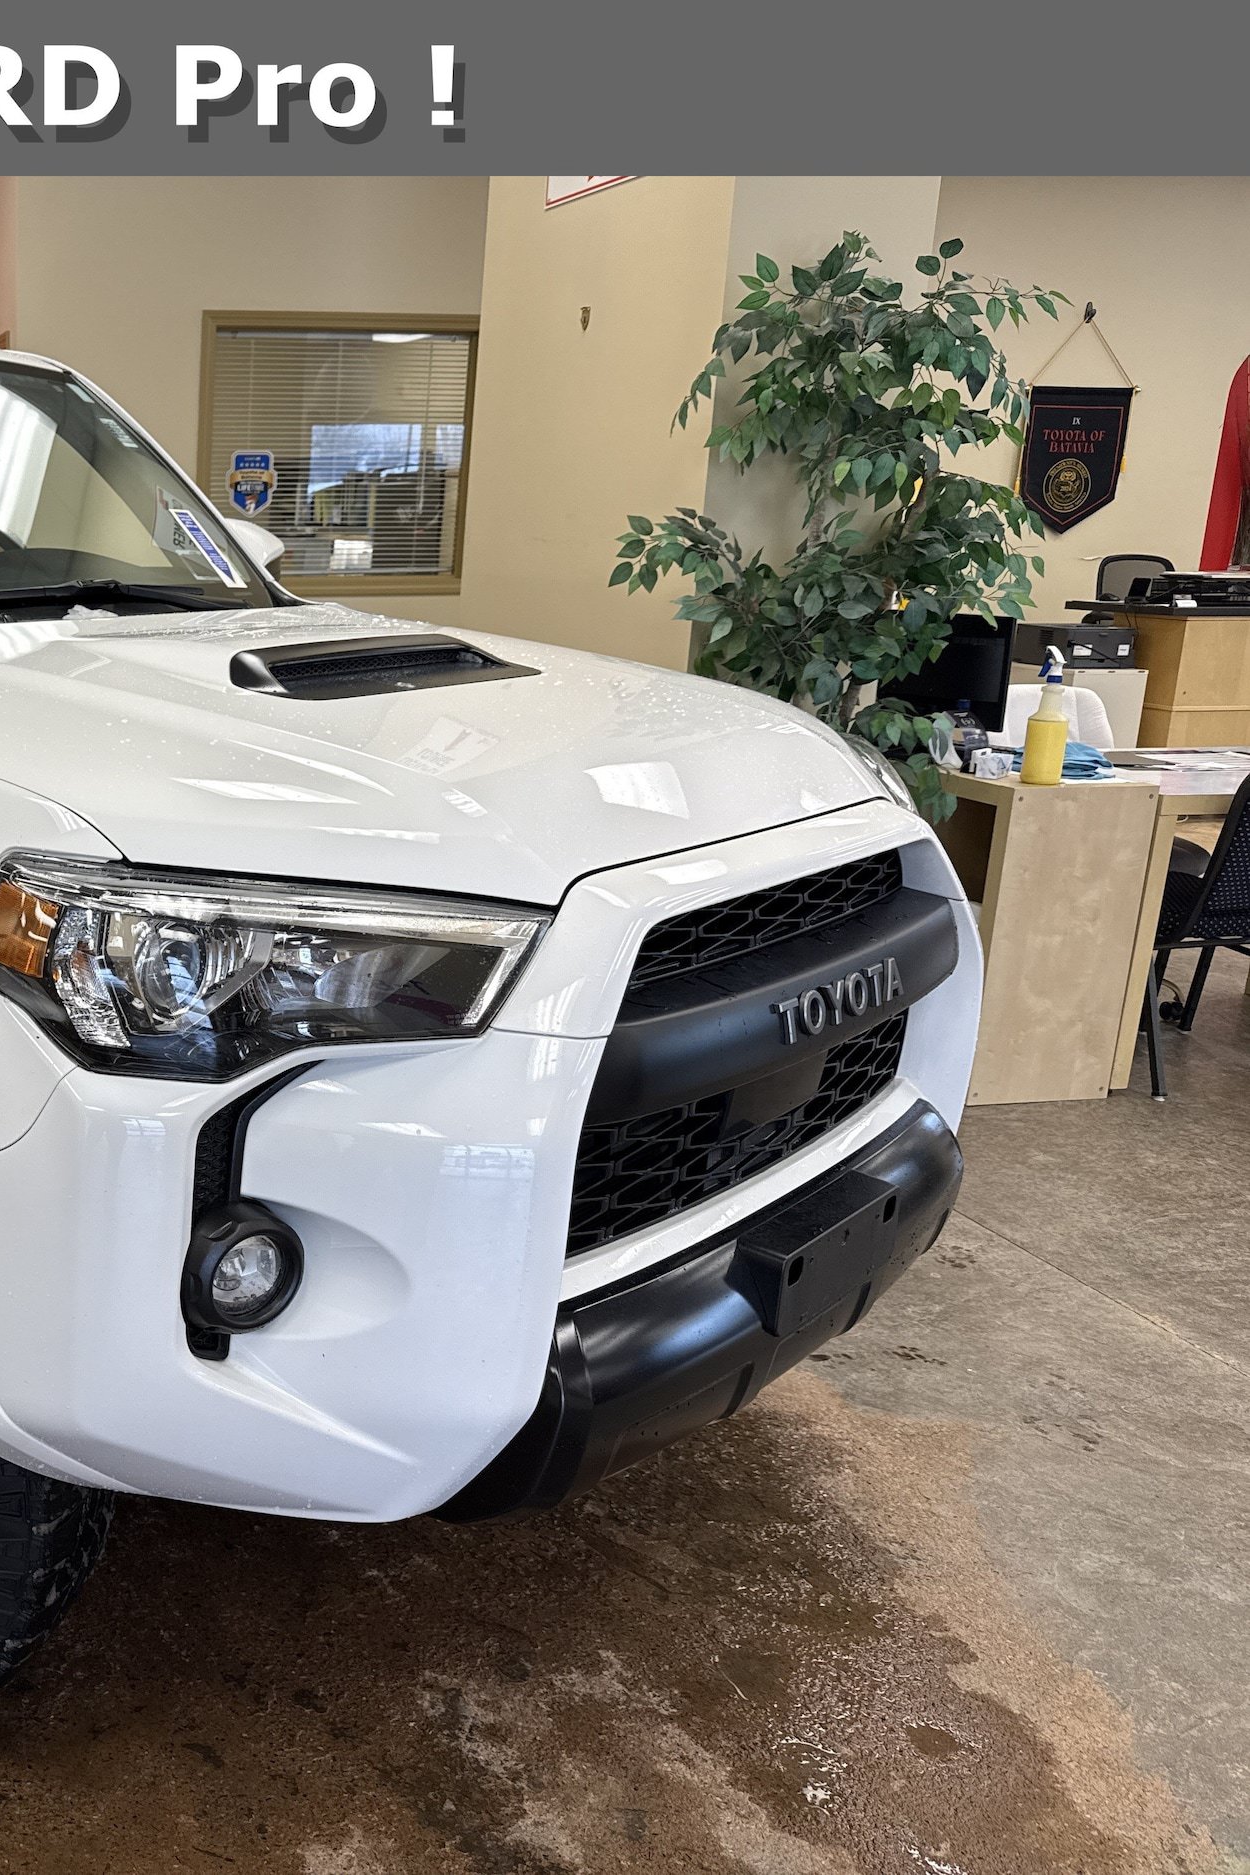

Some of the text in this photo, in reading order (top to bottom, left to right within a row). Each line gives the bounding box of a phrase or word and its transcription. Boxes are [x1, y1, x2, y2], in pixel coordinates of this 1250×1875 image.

[1042, 428, 1106, 442] TOYOTA OF
[1049, 441, 1095, 454] BATAVIA
[769, 957, 904, 1045] TOYOTA
